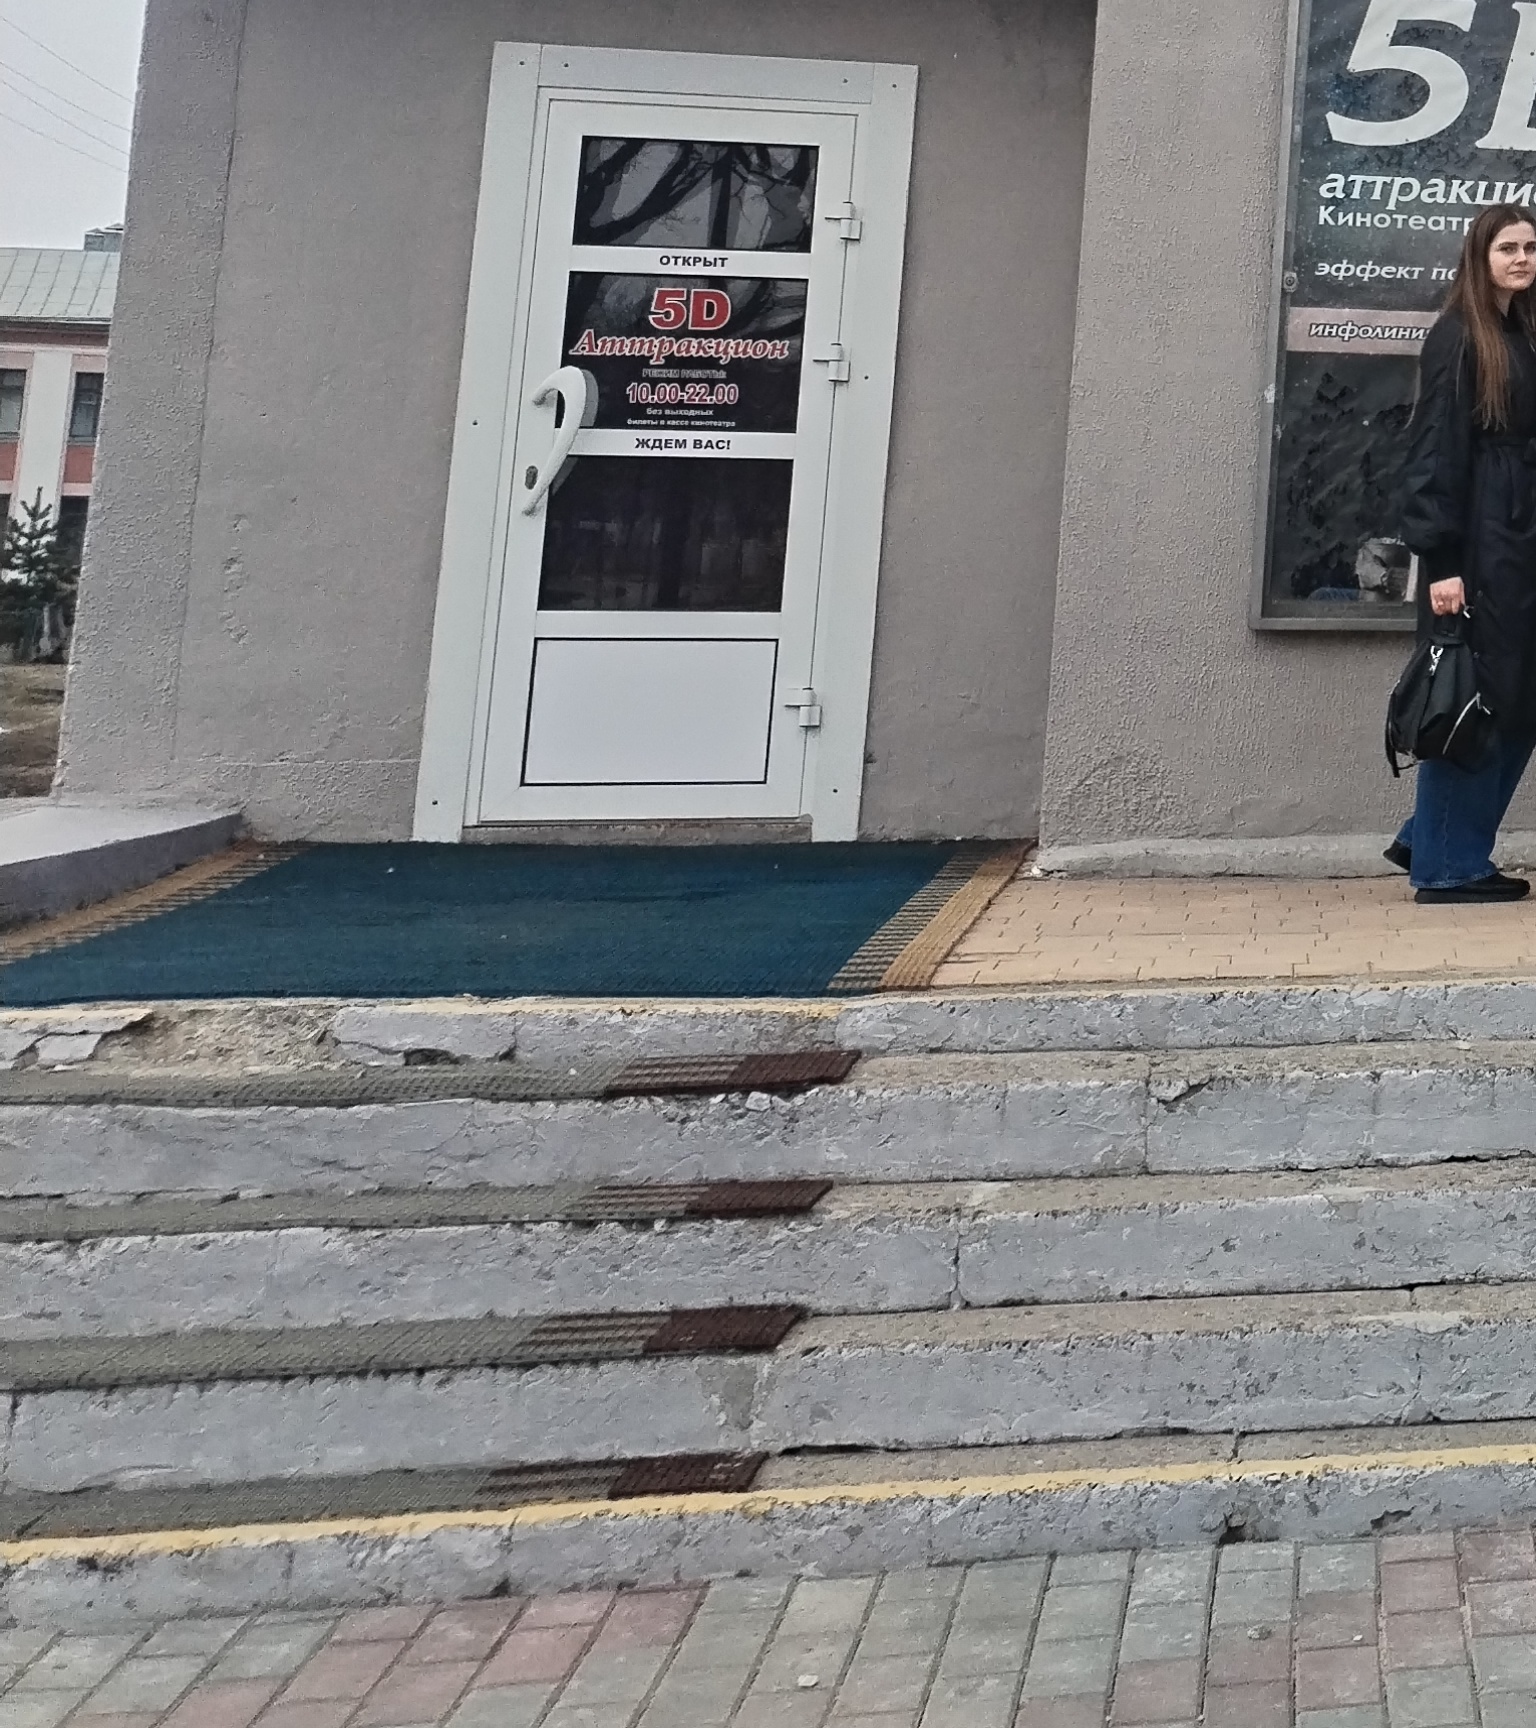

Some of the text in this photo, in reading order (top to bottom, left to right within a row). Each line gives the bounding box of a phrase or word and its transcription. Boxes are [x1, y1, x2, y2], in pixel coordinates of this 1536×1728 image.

[659, 255, 729, 268] ОТКРЫТ
[1314, 259, 1424, 283] эффект
[649, 287, 731, 330] 5D
[569, 328, 790, 364] Аттракцион
[642, 368, 680, 379] РЕЖИМ
[626, 382, 739, 405] 10.00-22.00
[646, 407, 714, 418] без выходных
[627, 418, 658, 427] билеты
[667, 419, 689, 427] кассе
[690, 419, 736, 429] кинотеатра
[635, 437, 731, 451] ЖДЕМ ВАС!
